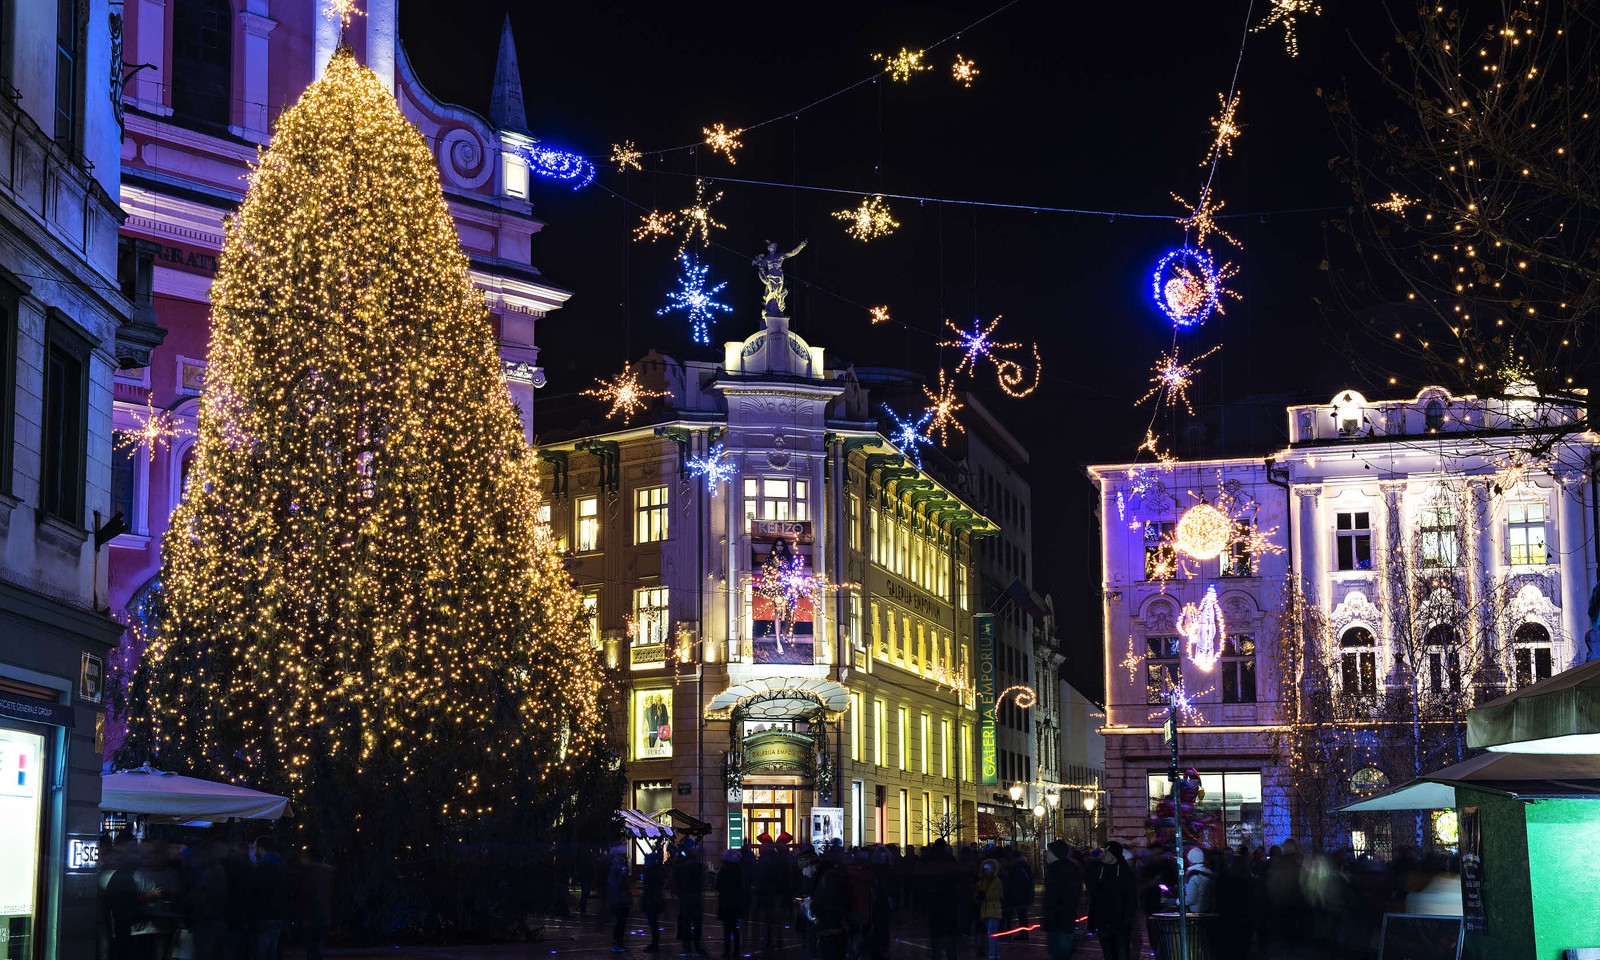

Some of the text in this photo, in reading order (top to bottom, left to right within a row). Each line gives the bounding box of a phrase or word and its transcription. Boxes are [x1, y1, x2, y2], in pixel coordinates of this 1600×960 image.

[759, 521, 804, 534] KENZO
[886, 579, 941, 621] GALERIJA EMPORIUM
[981, 622, 996, 777] GALERIJA EMPORIUM
[38, 707, 53, 717] GROUP
[751, 749, 776, 758] GALERIJA
[82, 845, 99, 863] SKB
